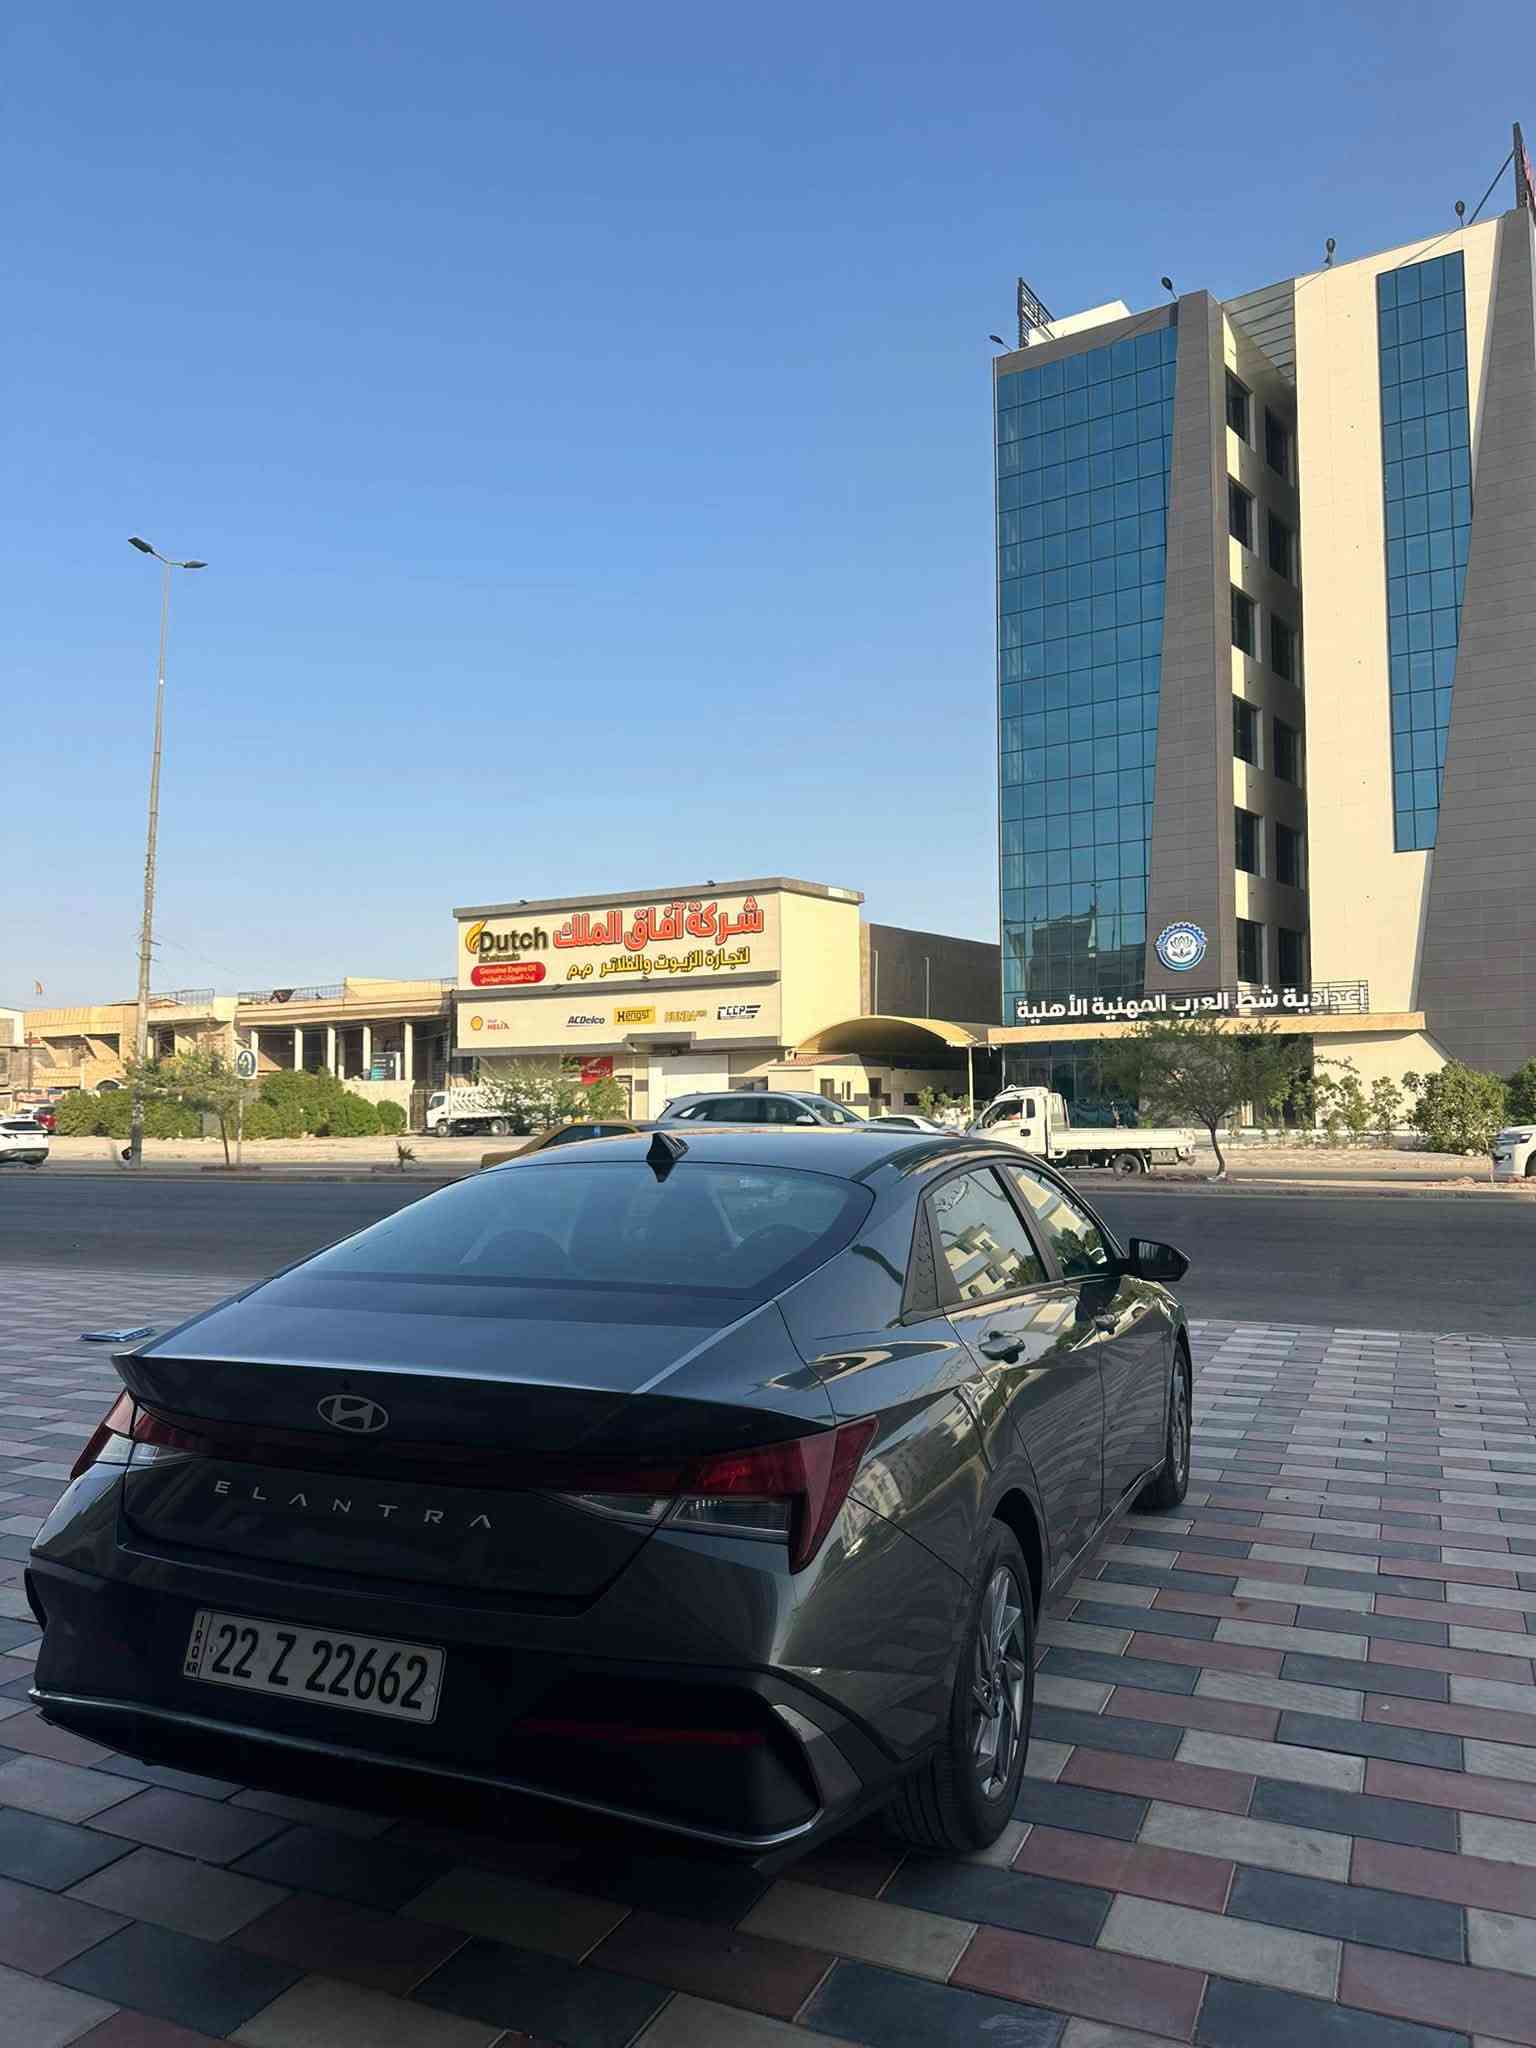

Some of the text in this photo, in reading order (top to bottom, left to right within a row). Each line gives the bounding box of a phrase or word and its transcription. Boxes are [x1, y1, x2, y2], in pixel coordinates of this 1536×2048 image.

[553, 896, 764, 950] شركة آفاق الملك
[480, 927, 548, 952] Dutch
[654, 950, 703, 973] الزيوت
[704, 946, 750, 970] لتجارة
[1016, 994, 1088, 1024] الأهلية
[1092, 994, 1167, 1021] المهنية
[1171, 991, 1229, 1018] العرب
[1283, 985, 1366, 1014] إعدادية
[568, 1015, 606, 1025] ACDelco
[214, 1480, 492, 1529] ELANTRA
[212, 1624, 428, 1710] 22 Z 22662
